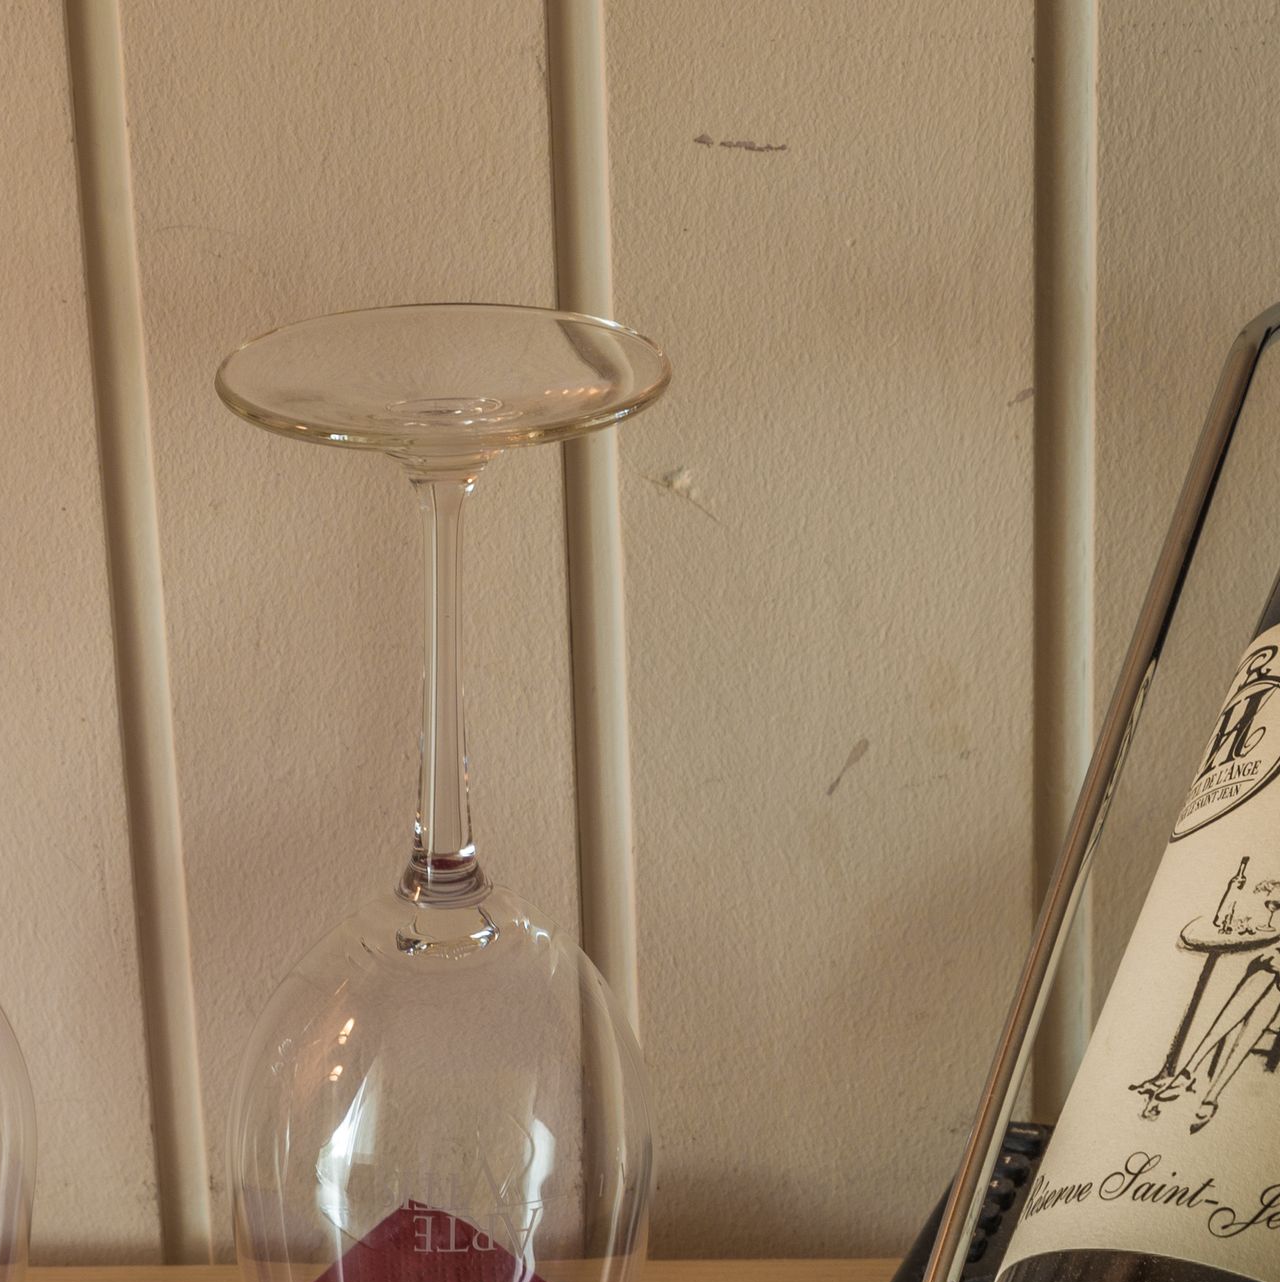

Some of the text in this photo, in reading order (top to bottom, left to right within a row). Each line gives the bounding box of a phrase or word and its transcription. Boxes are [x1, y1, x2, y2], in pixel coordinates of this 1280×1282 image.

[1216, 760, 1261, 785] L'ANGE
[1217, 784, 1241, 800] JEAN
[412, 1206, 543, 1259] ARTE
